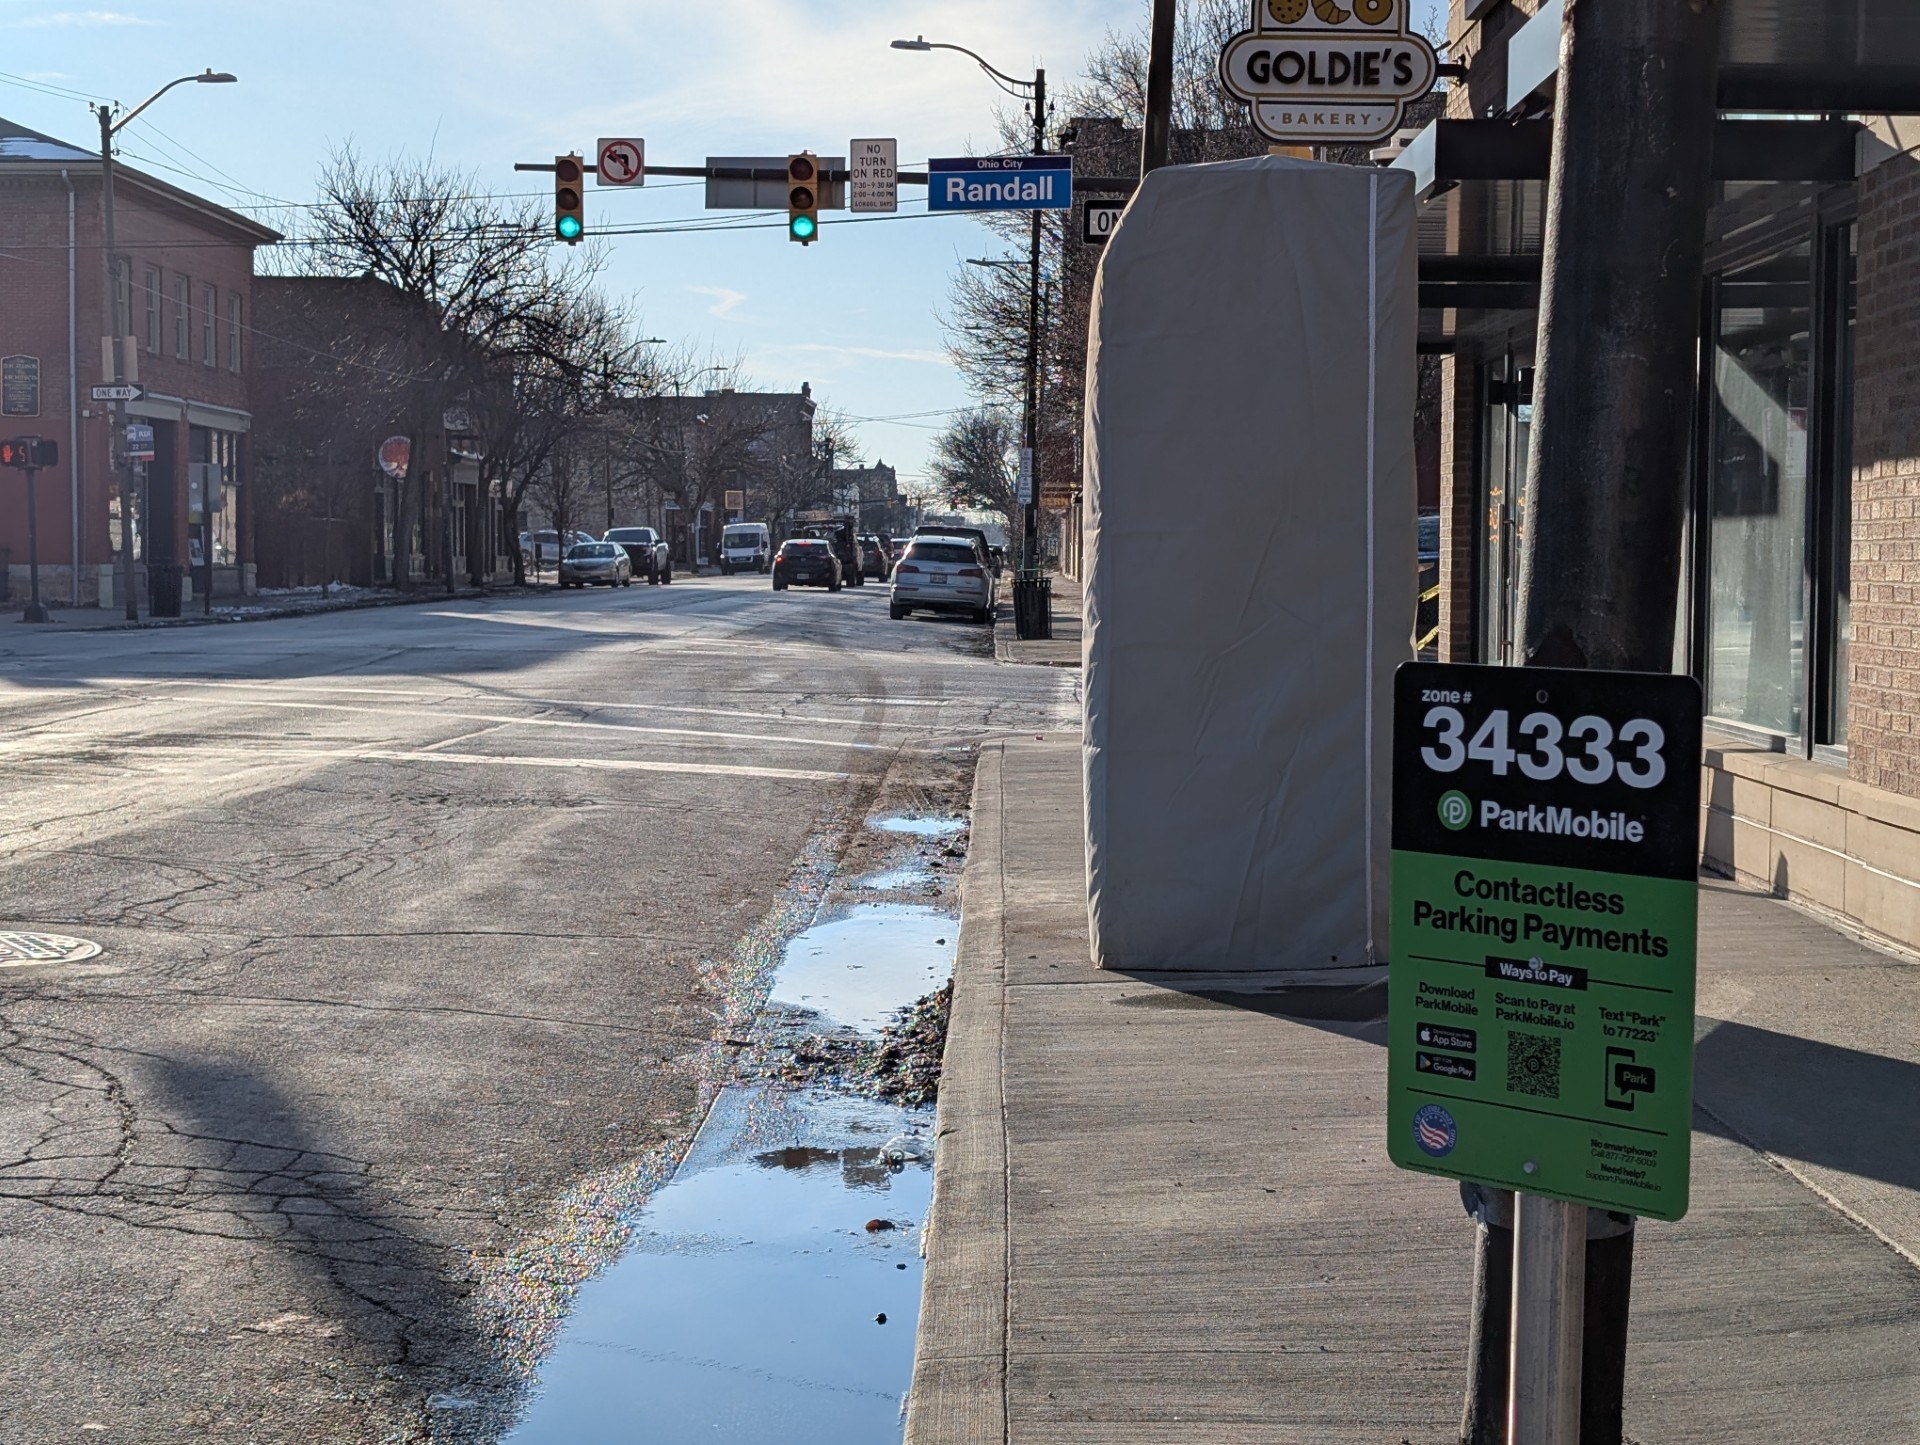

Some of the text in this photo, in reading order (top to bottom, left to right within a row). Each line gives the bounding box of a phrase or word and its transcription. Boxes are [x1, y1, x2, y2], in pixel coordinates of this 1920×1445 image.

[1247, 48, 1413, 86] GOLDIE'S
[1282, 113, 1371, 125] BAKERY
[866, 144, 881, 154] NO
[859, 156, 887, 166] TURN
[977, 159, 1023, 170] Ohio City
[853, 168, 893, 178] ON RED
[885, 190, 894, 198] PM
[946, 176, 1053, 202] Randall
[96, 388, 132, 398] ONE WAY
[1421, 689, 1461, 703] zone
[1420, 705, 1666, 789] 34333
[1480, 799, 1645, 843] ParkMobile
[1453, 869, 1625, 916] Contactless
[1413, 899, 1669, 958] Parking Payments
[1500, 962, 1573, 986] Ways to Pay
[1419, 981, 1475, 1000] Download
[1415, 995, 1478, 1016] ParkMobile
[1495, 992, 1576, 1015] Scan to Pay at
[1495, 1007, 1575, 1030] ParkMobile.io
[1598, 1006, 1625, 1022] Text
[1603, 1024, 1616, 1036] to
[1432, 1034, 1473, 1049] App Store
[1433, 1062, 1473, 1078] Google Play
[1622, 1071, 1648, 1085] Park
[1590, 1138, 1658, 1158] No smartphone?
[1600, 1163, 1647, 1179] Need help?
